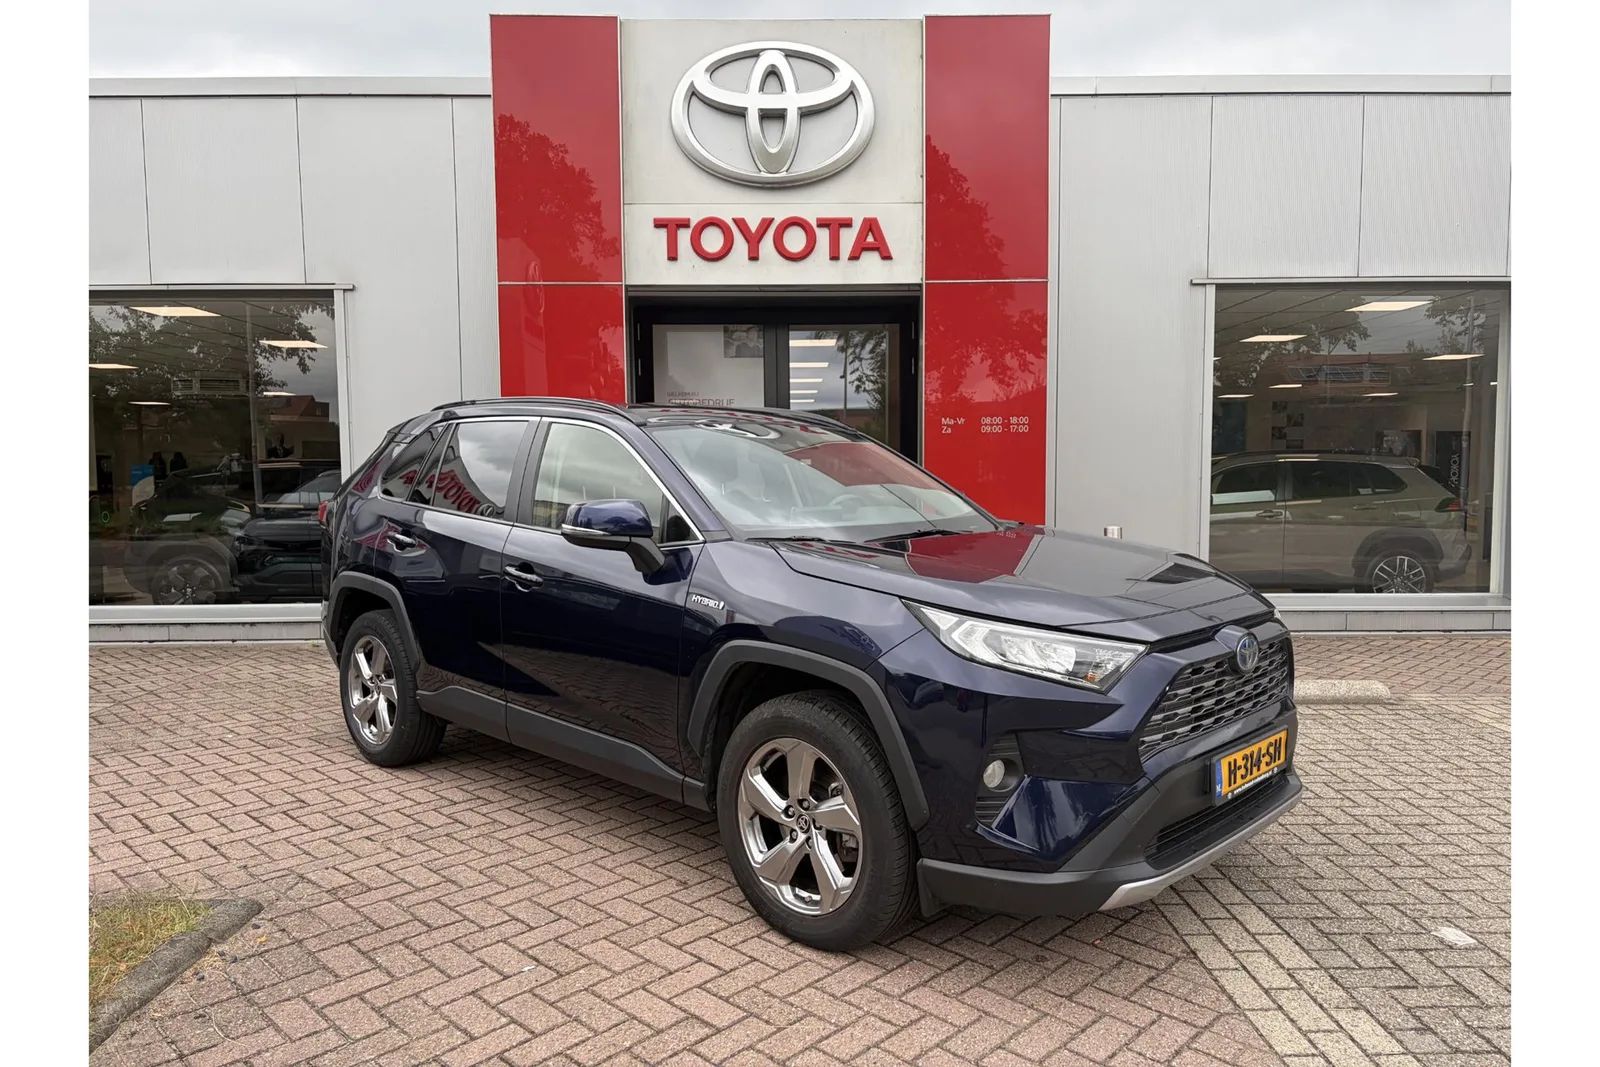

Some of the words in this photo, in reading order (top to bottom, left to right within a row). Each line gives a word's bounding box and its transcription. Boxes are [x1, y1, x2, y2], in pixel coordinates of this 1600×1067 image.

[653, 216, 893, 262] TOYOTA
[941, 417, 966, 425] Ma-Vr
[981, 416, 1003, 425] 08:00
[1009, 416, 1029, 424] 18:00
[941, 426, 952, 434] Za
[981, 425, 1003, 433] 09:00
[1009, 425, 1029, 433] 17:00
[691, 594, 719, 609] HYBRID
[1227, 736, 1283, 788] H-314-SH
